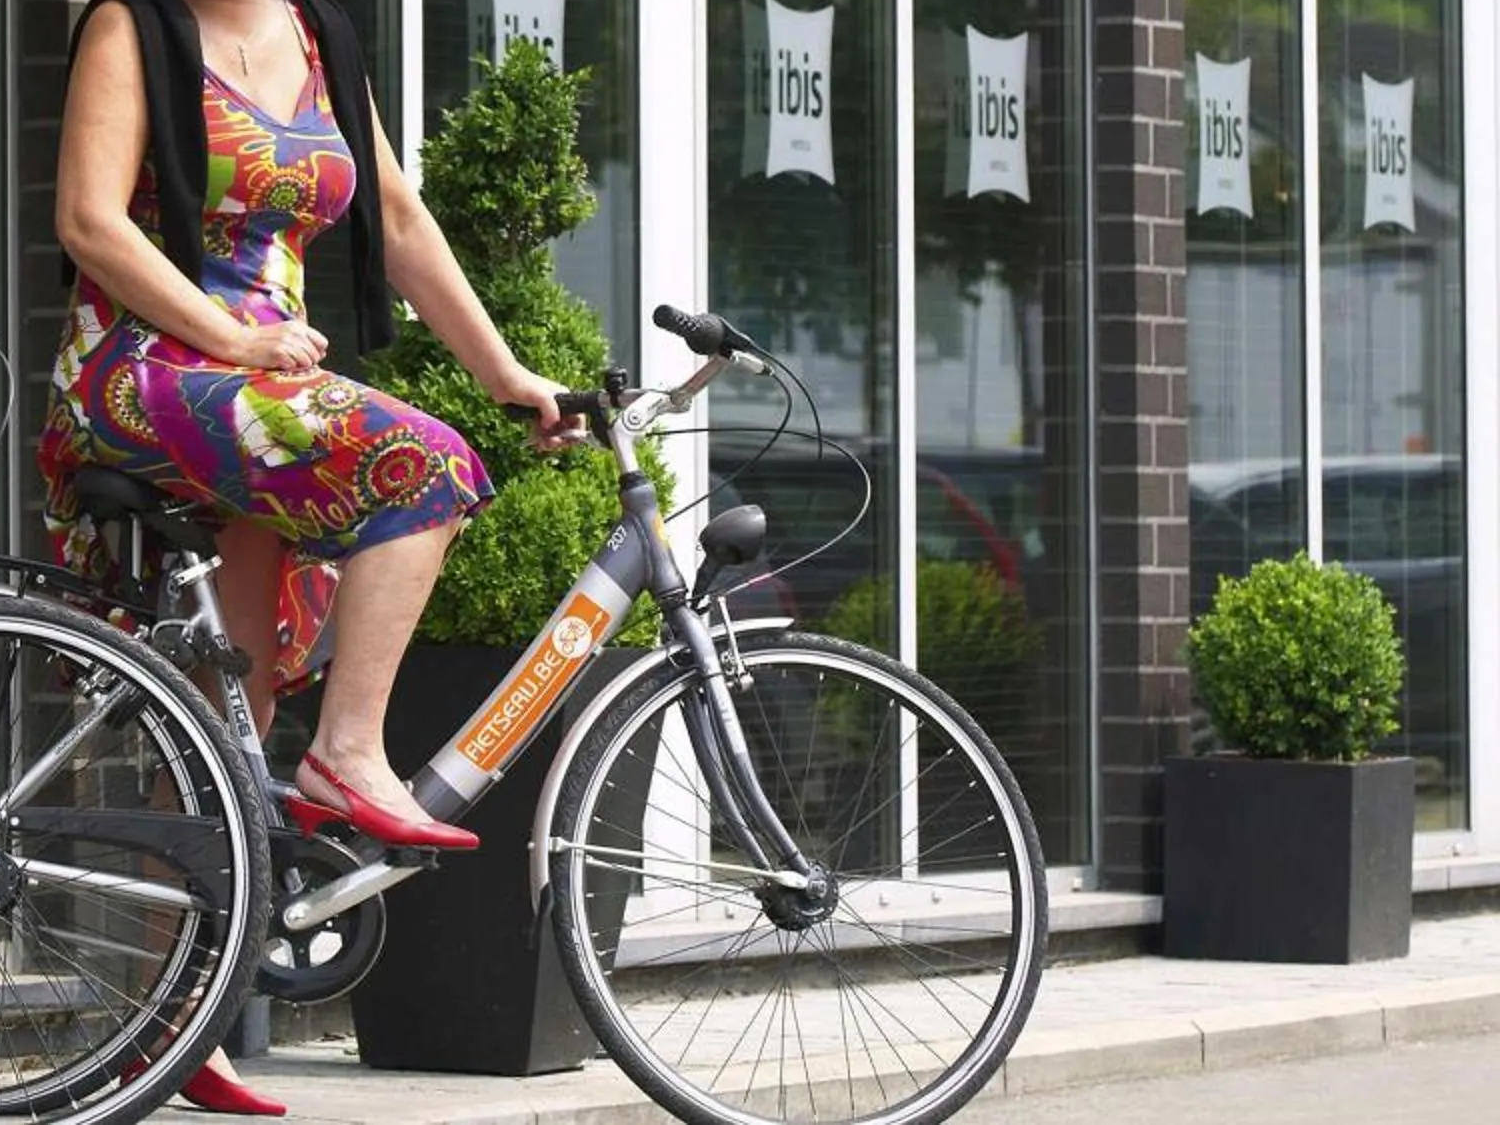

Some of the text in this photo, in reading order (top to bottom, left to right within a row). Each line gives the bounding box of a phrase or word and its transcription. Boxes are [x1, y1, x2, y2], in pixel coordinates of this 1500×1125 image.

[778, 48, 823, 120] ibis
[978, 75, 1019, 140] ibis
[1206, 99, 1243, 160] ibis
[1371, 117, 1406, 176] ibis
[606, 525, 628, 552] 207
[213, 634, 253, 737] PSTIGE
